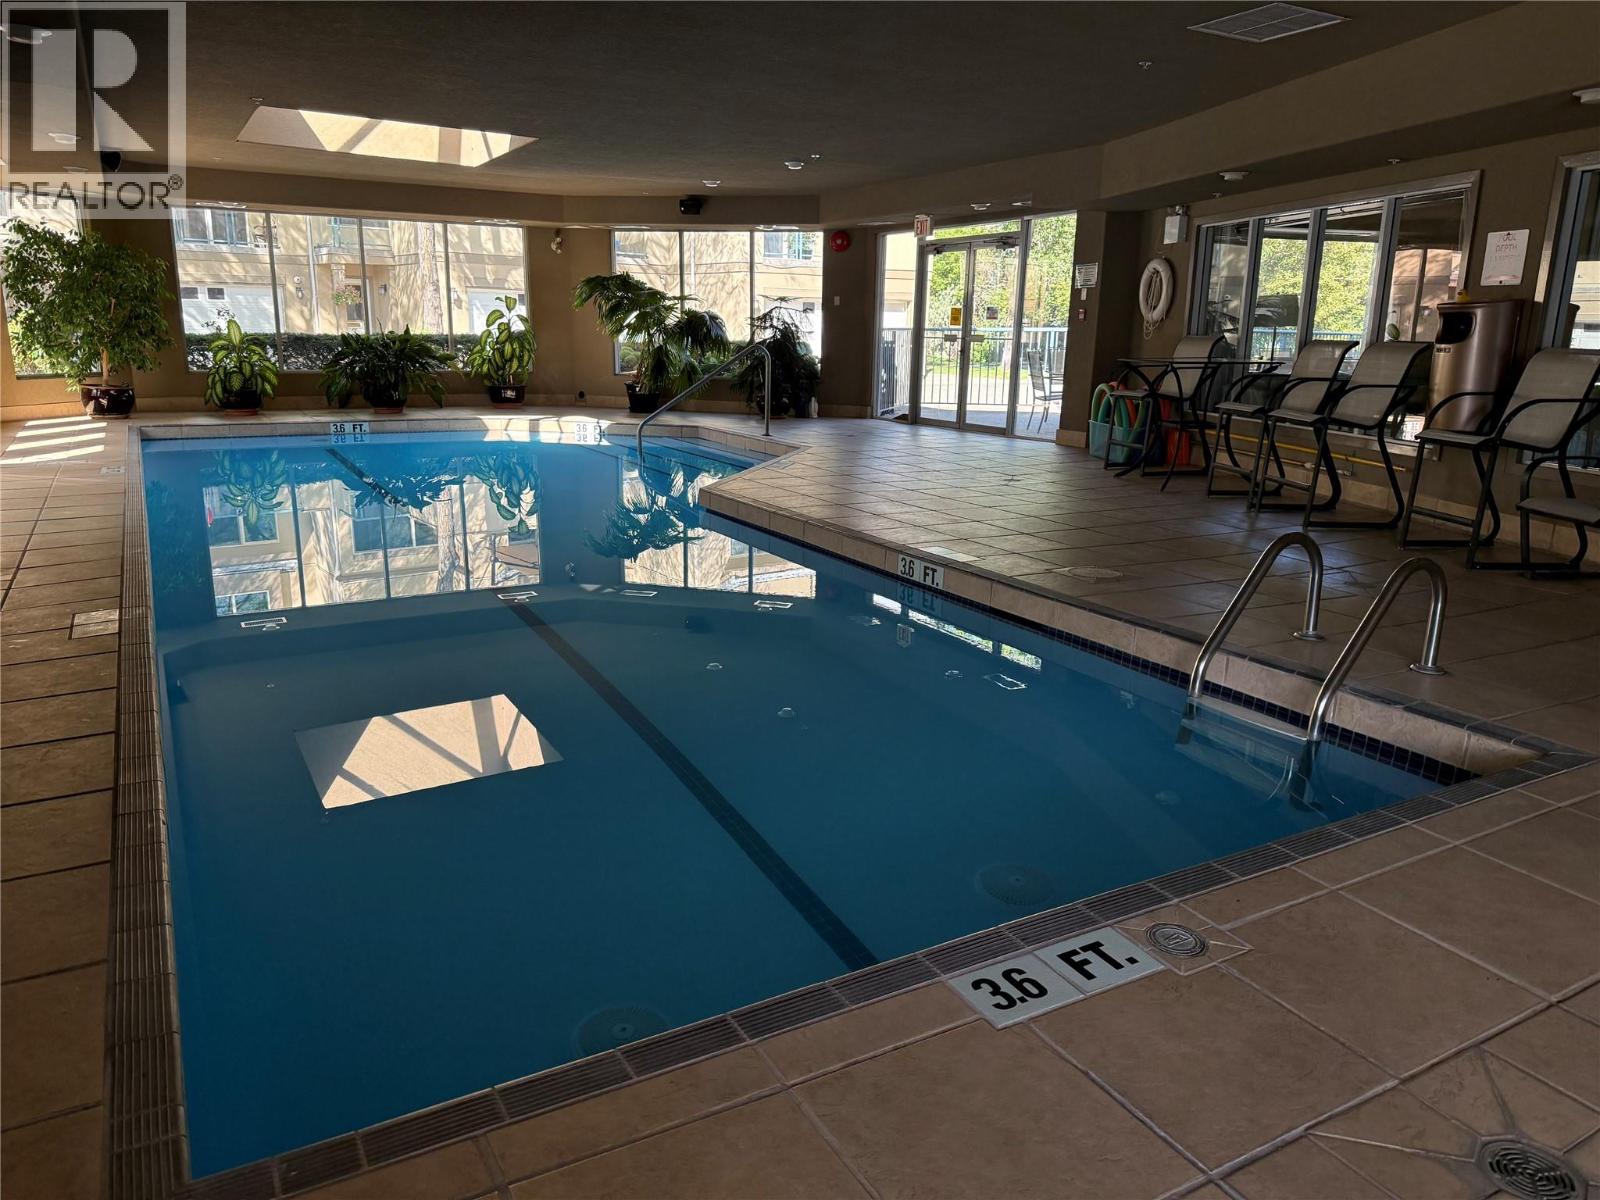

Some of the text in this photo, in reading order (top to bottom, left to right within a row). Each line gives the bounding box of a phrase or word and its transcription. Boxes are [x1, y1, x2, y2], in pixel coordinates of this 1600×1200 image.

[916, 218, 928, 236] EXIT
[332, 423, 366, 434] 3.6 FT.
[900, 556, 939, 587] 3.6 FT.
[970, 940, 1139, 1011] 3.6 FT.
